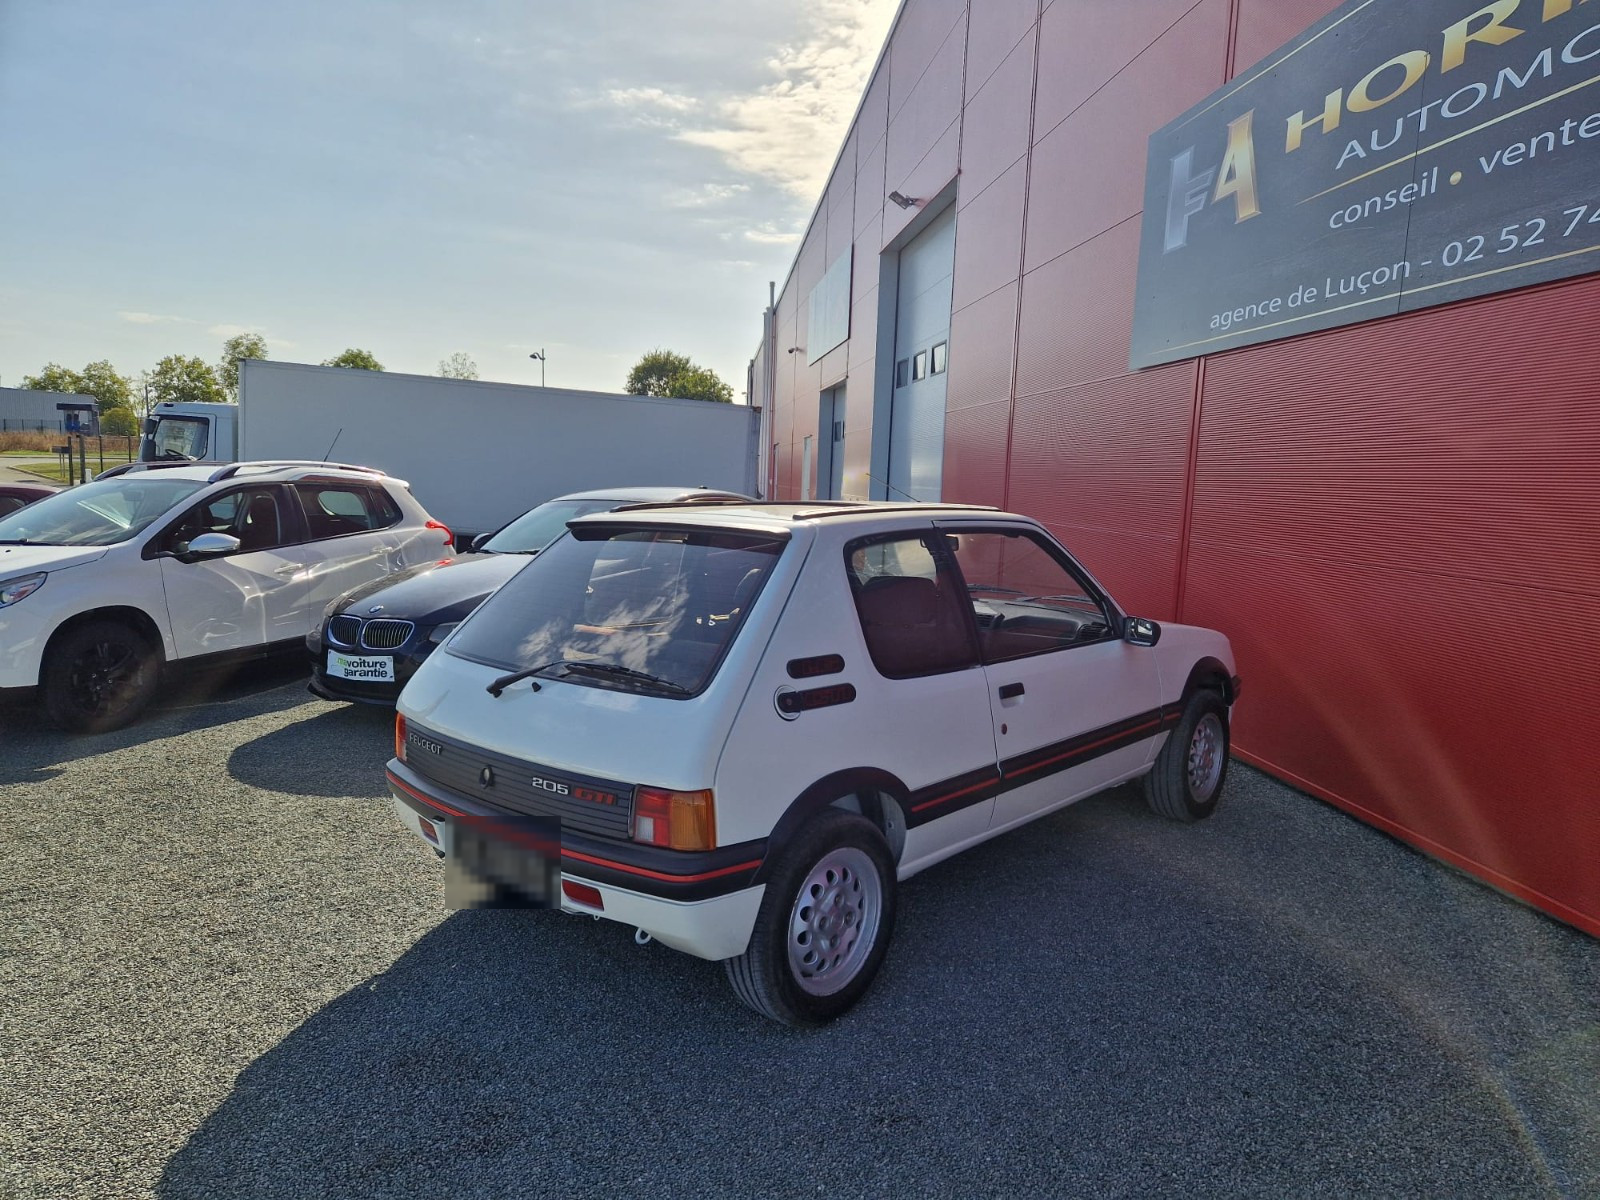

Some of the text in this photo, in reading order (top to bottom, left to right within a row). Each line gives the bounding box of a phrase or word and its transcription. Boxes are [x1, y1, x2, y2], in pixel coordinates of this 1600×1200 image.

[1285, 0, 1589, 153] HOR
[1329, 112, 1600, 229] conseil vente
[1210, 298, 1281, 330] agence
[1287, 285, 1317, 308] de
[1325, 260, 1410, 295] Luçon
[1442, 235, 1485, 267] 02
[1497, 218, 1546, 253] 52
[344, 667, 388, 678] garantie
[409, 732, 442, 755] PEUGEOT
[532, 776, 569, 795] 205
